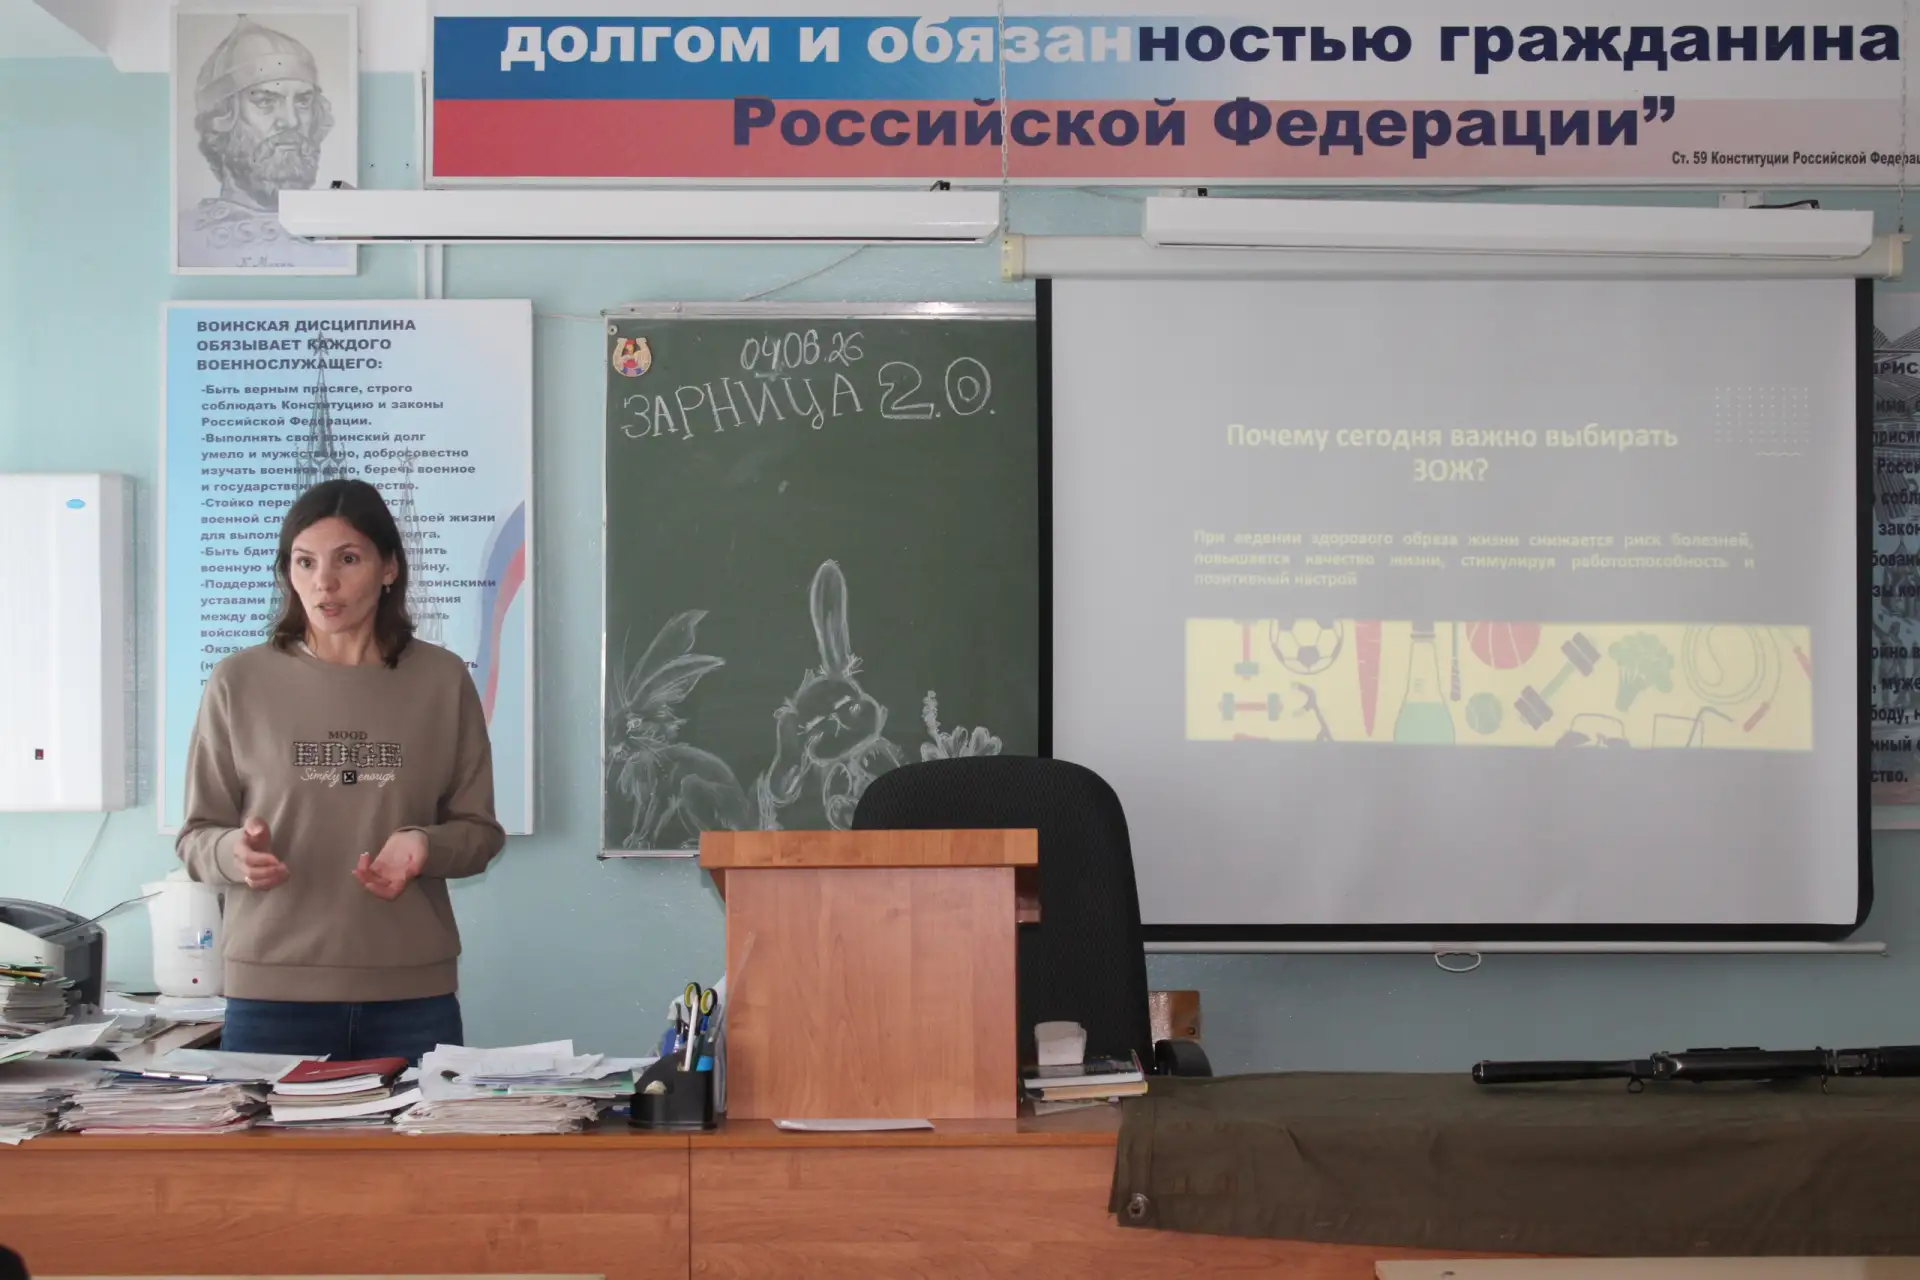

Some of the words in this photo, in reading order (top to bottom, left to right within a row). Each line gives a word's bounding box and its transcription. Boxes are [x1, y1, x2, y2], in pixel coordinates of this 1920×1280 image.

[500, 25, 770, 72] долгом
[800, 26, 840, 62] и
[867, 16, 1412, 63] обязанностью
[1440, 25, 1900, 74] гражданина
[733, 95, 1185, 147] Российской
[1672, 151, 1690, 165] Ст.
[1693, 151, 1708, 165] 59
[1711, 151, 1789, 168] Конституции
[1793, 150, 1867, 165] Российской
[196, 320, 290, 332] ВОИНСКАЯ
[294, 319, 417, 334] ДИСЦИПЛИНА
[196, 339, 302, 351] ОБЯЗЫВАЕТ
[307, 338, 392, 352] КАЖДОГО
[196, 358, 383, 371] ВОЕННОСЛУЖАЩЕГО:
[201, 385, 240, 394] -Быть
[244, 386, 299, 396] верным
[303, 385, 363, 396] присяге,
[367, 385, 413, 395] строго
[201, 400, 277, 412] соблюдать
[281, 400, 374, 411] Конституцию
[378, 401, 387, 409] и
[391, 400, 444, 409] законы
[621, 373, 864, 440] ЗАРНИЦА
[201, 415, 286, 426] Российской
[289, 416, 373, 427] Федерации.
[201, 433, 282, 443] -Выполнять
[286, 433, 319, 442] свой
[324, 432, 390, 441] воинский
[394, 433, 426, 442] долг
[1226, 423, 1330, 452] Почему
[1336, 428, 1443, 451] сегодня
[1450, 428, 1538, 447] важно
[1546, 423, 1679, 452] выбирать
[201, 451, 244, 461] умело
[249, 451, 257, 459] и
[262, 449, 360, 461] мужественно,
[363, 448, 469, 460] добросовестно
[201, 466, 256, 478] изучать
[260, 466, 319, 475] военное
[323, 465, 360, 476] дело,
[364, 464, 415, 476] беречь
[418, 466, 476, 474] военное
[1412, 458, 1489, 482] ЗОЖ?
[214, 483, 313, 493] государствен
[201, 498, 254, 508] -Стойко
[258, 499, 293, 509] пере
[201, 513, 259, 524] военной
[404, 513, 445, 522] своей
[200, 531, 226, 541] для
[229, 532, 281, 540] выполн
[1193, 530, 1225, 547] При
[1311, 533, 1394, 548] здорового
[1402, 531, 1459, 547] образа
[1468, 533, 1520, 547] жизни
[1529, 533, 1614, 547] снижается
[1624, 534, 1662, 549] риск
[1671, 532, 1754, 549] болезней,
[200, 547, 239, 556] -Быть
[1193, 553, 1291, 566] повышается
[1305, 553, 1375, 566] качество
[1389, 554, 1445, 569] жизни,
[1461, 555, 1555, 571] стимулируя
[1572, 553, 1730, 571] работоспособность
[1744, 556, 1755, 569] и
[201, 564, 261, 574] военную
[200, 579, 281, 590] -Поддержи
[418, 579, 496, 587] воинскими
[1193, 571, 1291, 585] позитивный
[1294, 571, 1358, 587] настрой
[201, 597, 266, 607] уставами
[201, 613, 246, 623] между
[328, 731, 368, 740] MOOD
[293, 742, 402, 768] EDGE
[301, 768, 340, 788] Simply
[357, 769, 396, 788] enough
